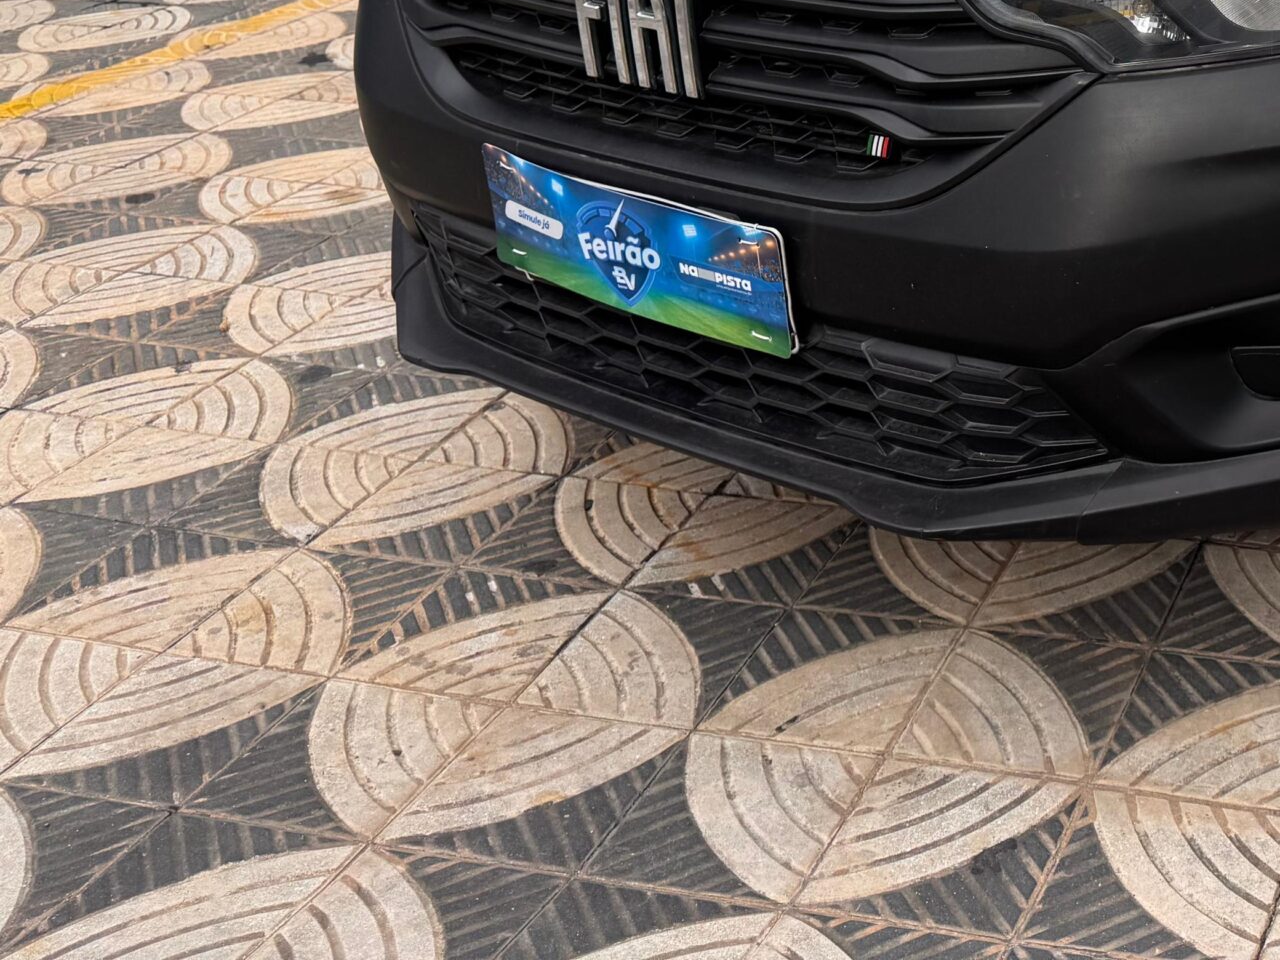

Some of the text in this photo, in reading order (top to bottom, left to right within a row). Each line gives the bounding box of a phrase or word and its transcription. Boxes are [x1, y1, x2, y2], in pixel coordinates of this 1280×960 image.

[518, 209, 550, 230] Simule já
[577, 231, 661, 270] Feirão
